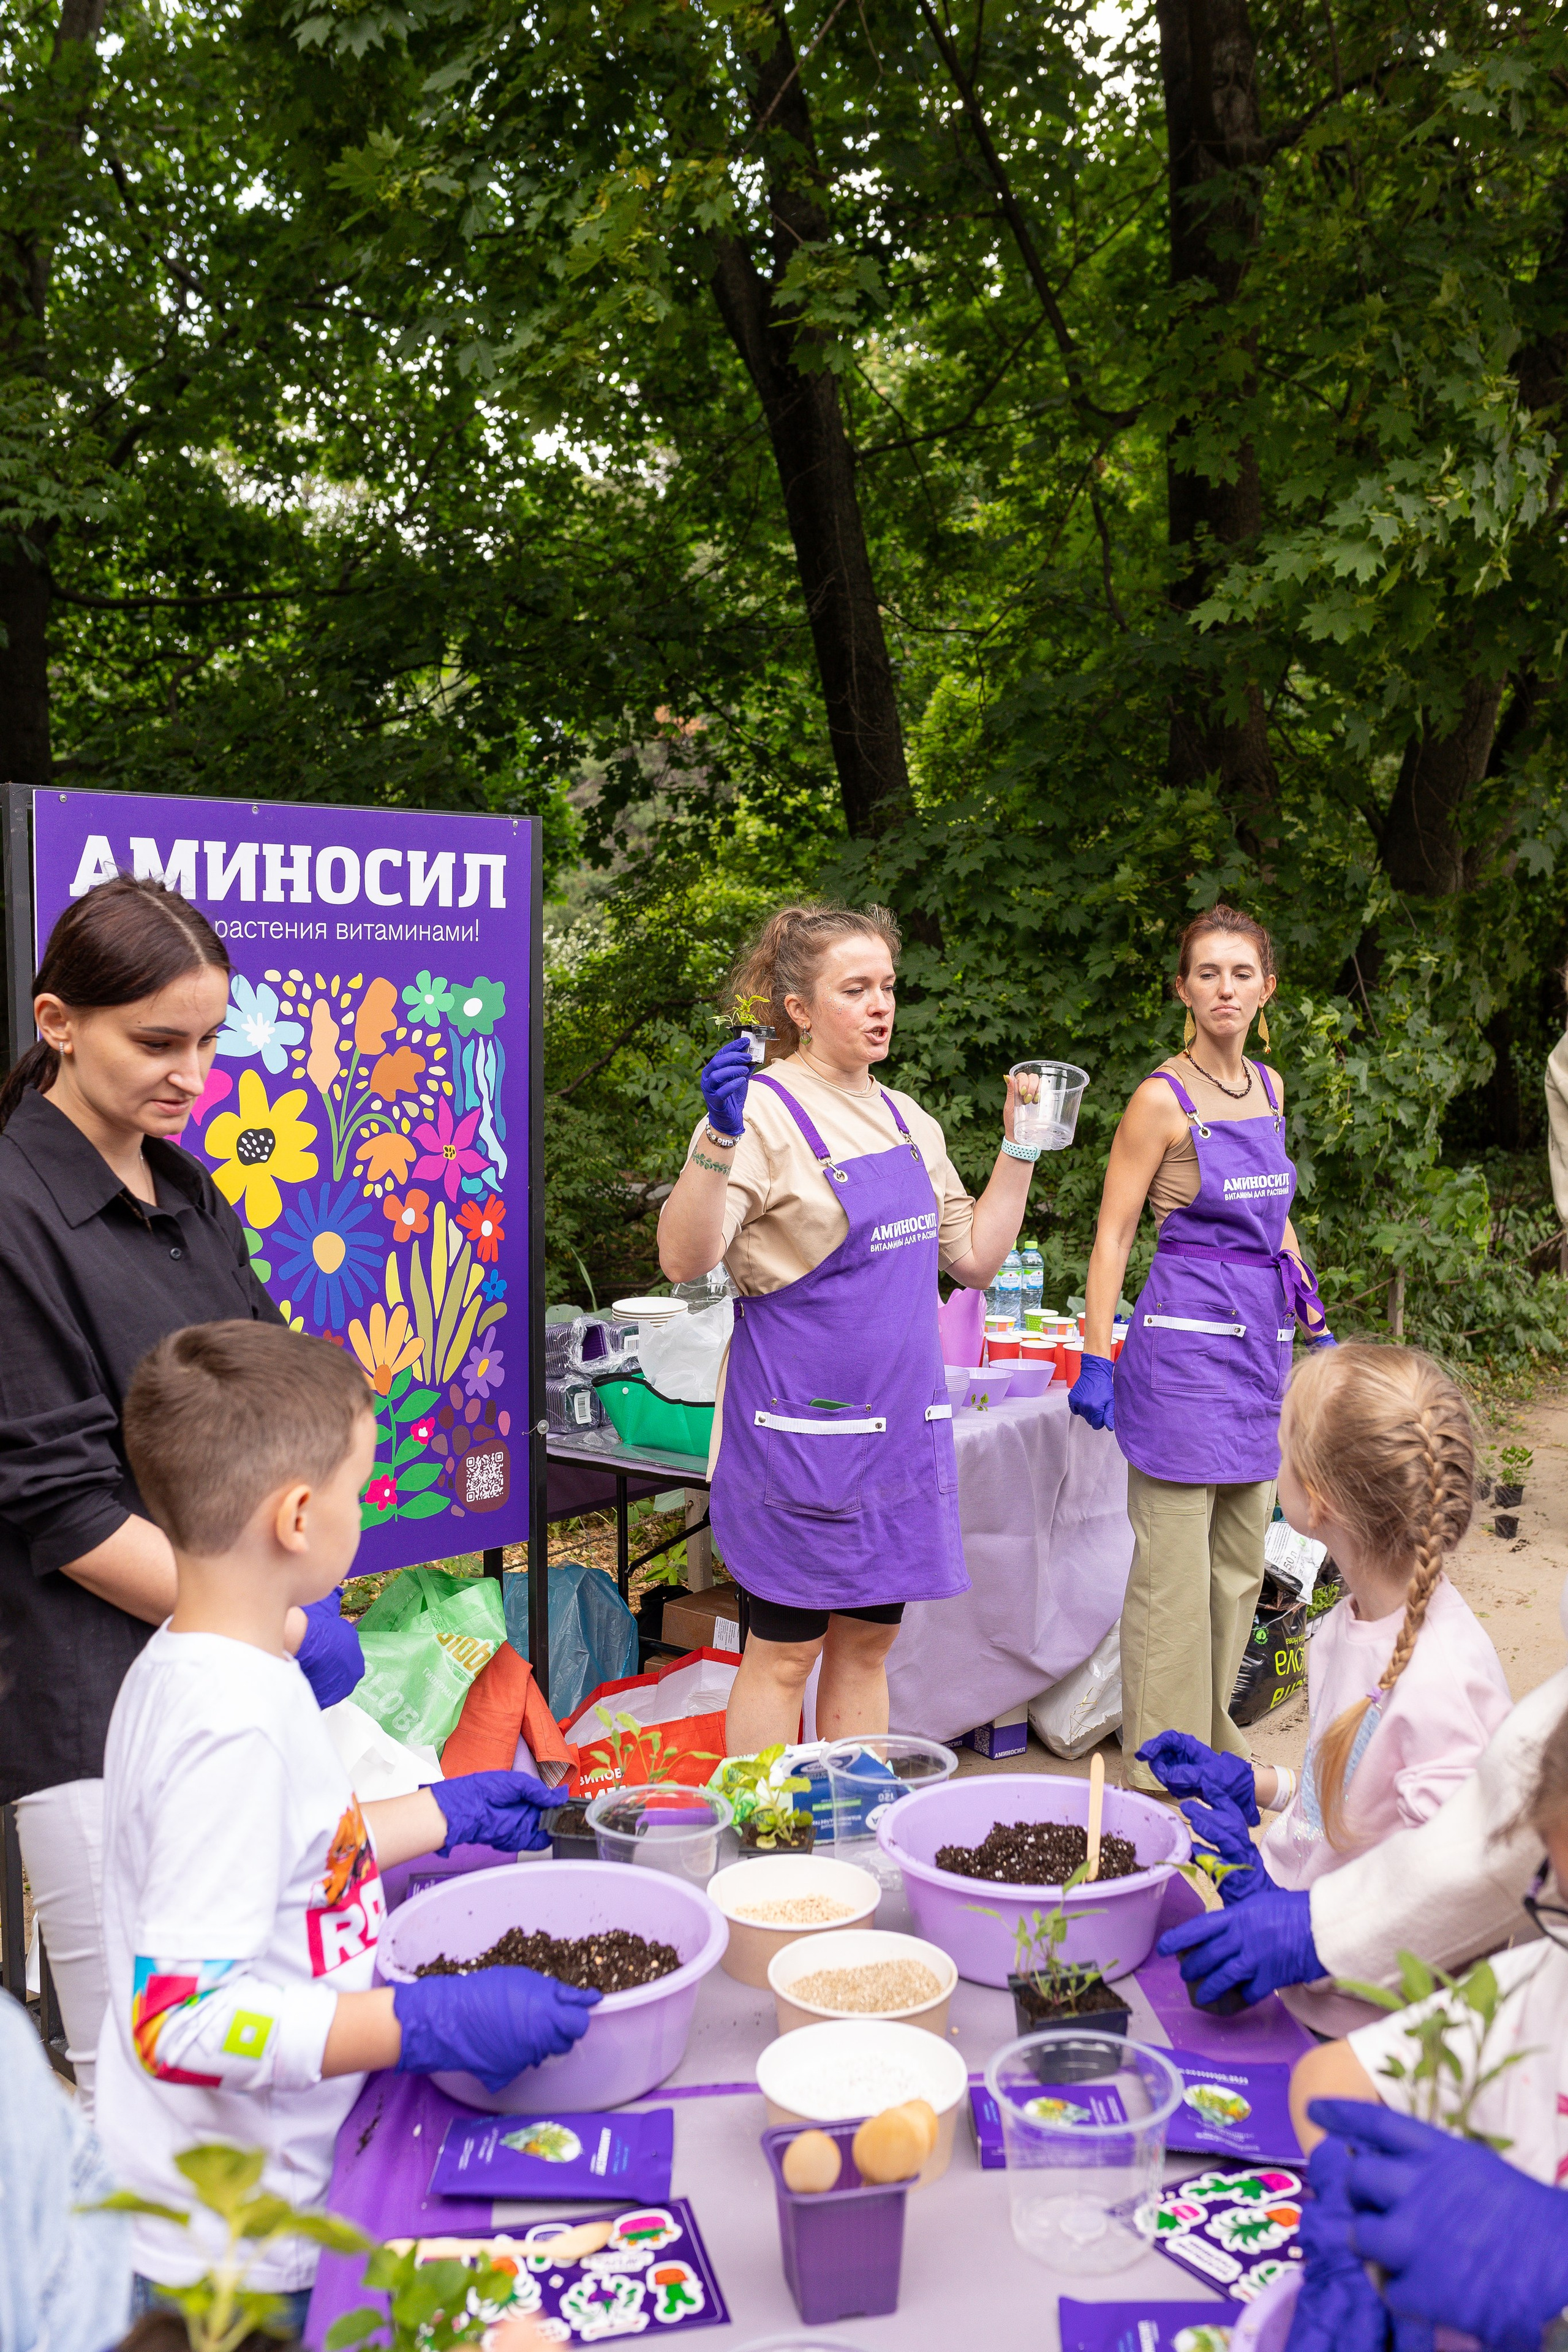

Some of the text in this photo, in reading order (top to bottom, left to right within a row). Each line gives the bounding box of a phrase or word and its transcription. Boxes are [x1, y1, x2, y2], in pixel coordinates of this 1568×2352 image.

[69, 835, 507, 908] АМИНОСИЛ
[215, 919, 480, 942] растения витаминами!
[1223, 1173, 1290, 1192] АМИНОСИЛ
[1225, 1186, 1289, 1200] ВИТАМИНЫ ДЛЯ РАСТЕНИЙ
[870, 1212, 937, 1242] АМИНОСИЛ
[870, 1237, 903, 1253] ВИТАМИНЫ
[904, 1235, 916, 1246] ДЛЯ
[994, 1747, 1025, 1759] АМИНОСИЛ
